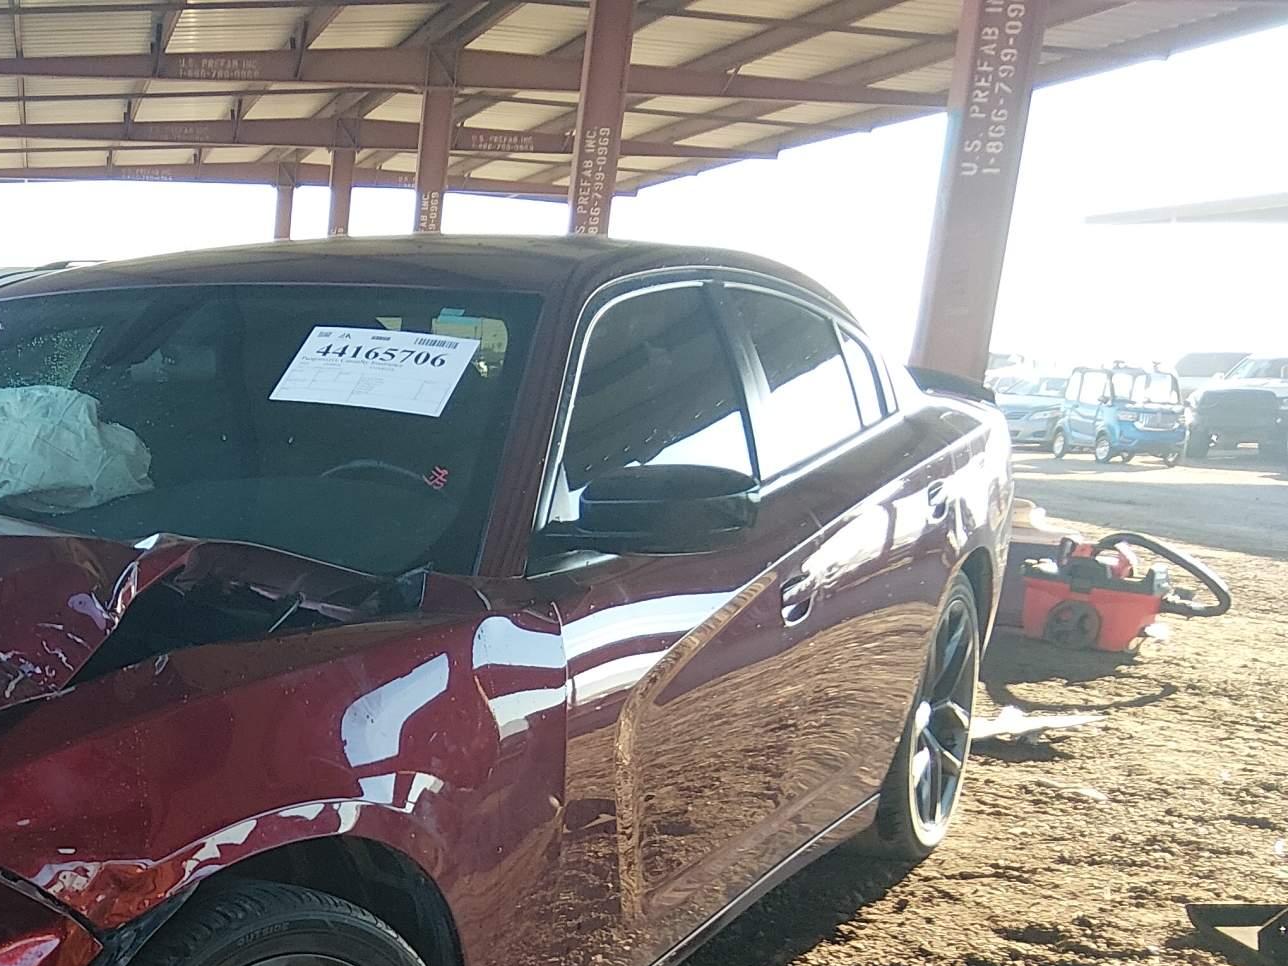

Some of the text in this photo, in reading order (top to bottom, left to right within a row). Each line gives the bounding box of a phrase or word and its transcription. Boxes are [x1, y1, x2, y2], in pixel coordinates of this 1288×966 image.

[969, 26, 1000, 118] PREFAB
[981, 2, 1026, 175] 1-866-799-09
[584, 126, 598, 153] INC.
[961, 132, 985, 176] U.S.
[576, 159, 594, 214] PREFAB
[587, 127, 611, 234] 866-799-0969
[315, 342, 448, 368] 44165706
